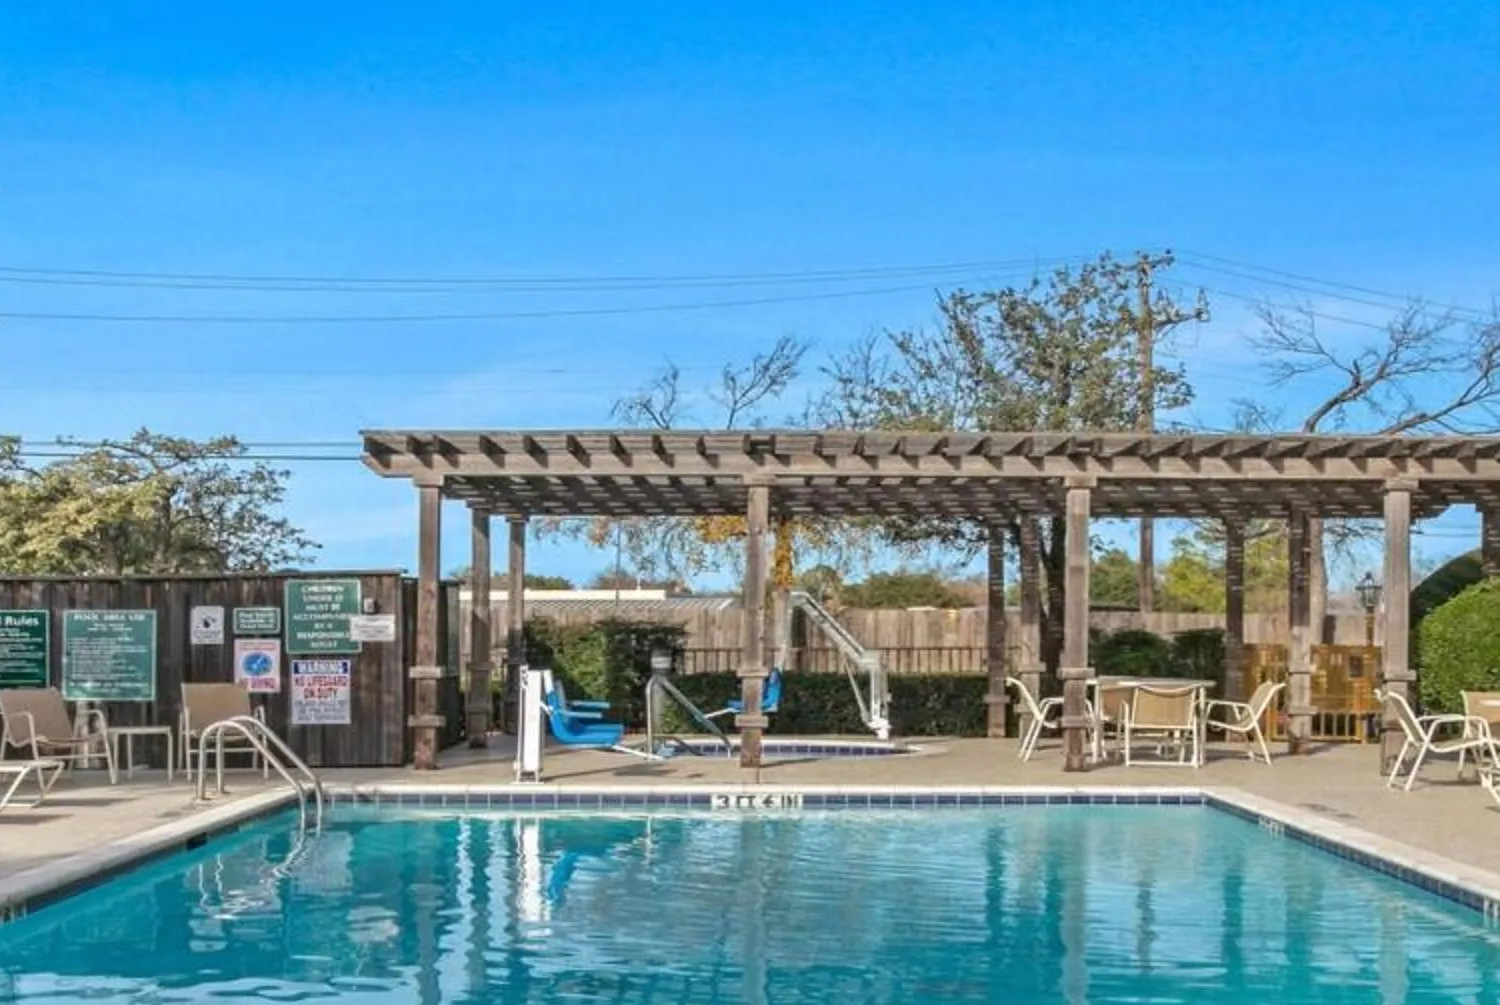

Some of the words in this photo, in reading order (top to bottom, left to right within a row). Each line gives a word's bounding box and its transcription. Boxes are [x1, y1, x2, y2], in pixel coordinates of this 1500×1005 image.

[5, 615, 39, 627] Rules
[297, 662, 343, 674] WARNING
[717, 795, 730, 809] 3
